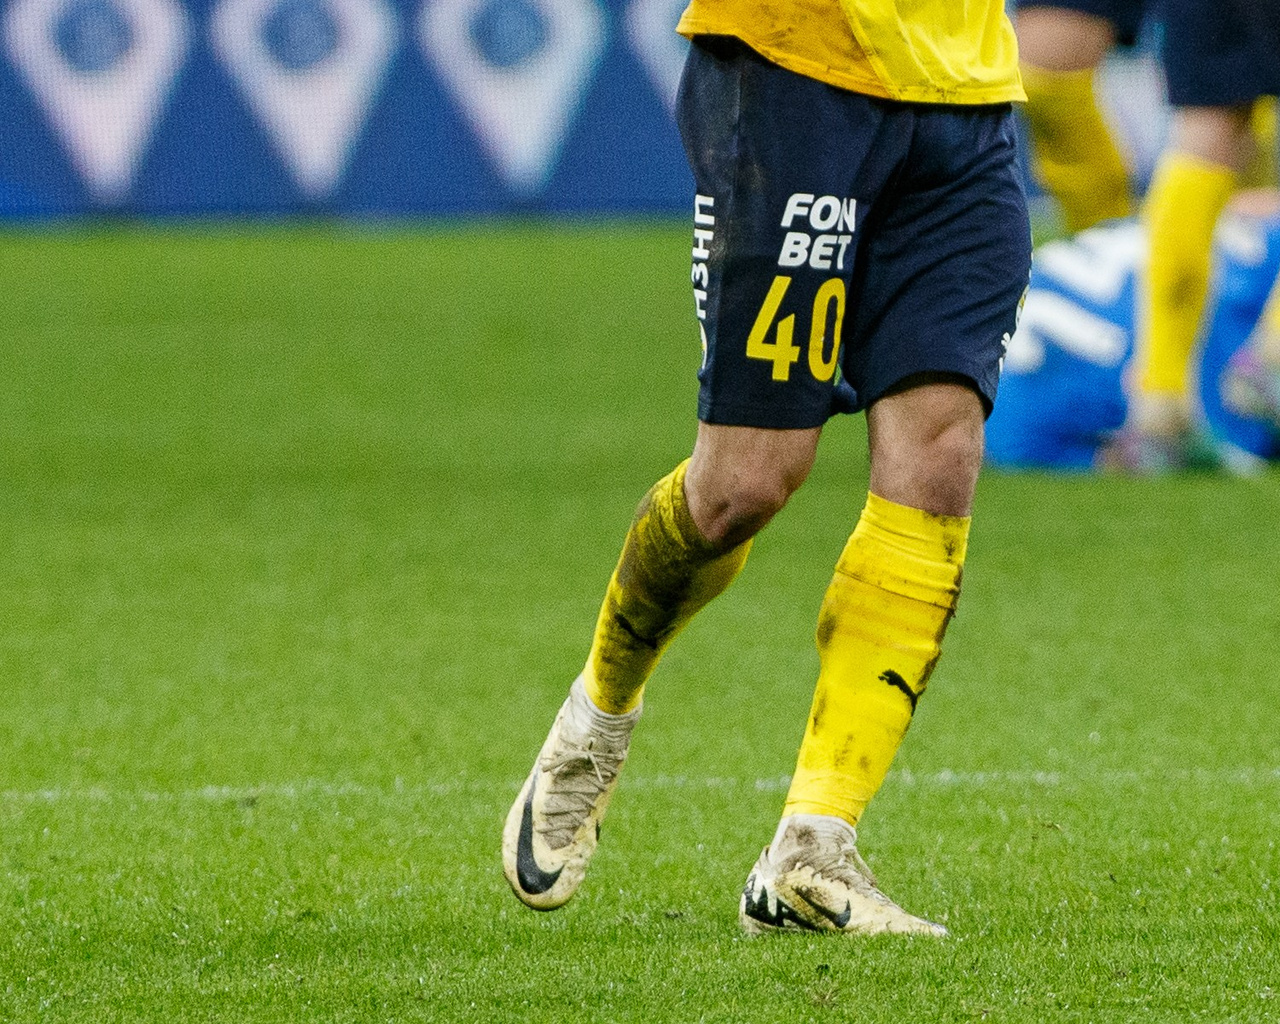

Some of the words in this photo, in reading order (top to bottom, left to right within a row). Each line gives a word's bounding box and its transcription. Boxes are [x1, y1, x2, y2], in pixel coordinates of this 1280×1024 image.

[780, 192, 857, 233] FON
[777, 231, 853, 270] BET
[745, 274, 847, 382] 40
